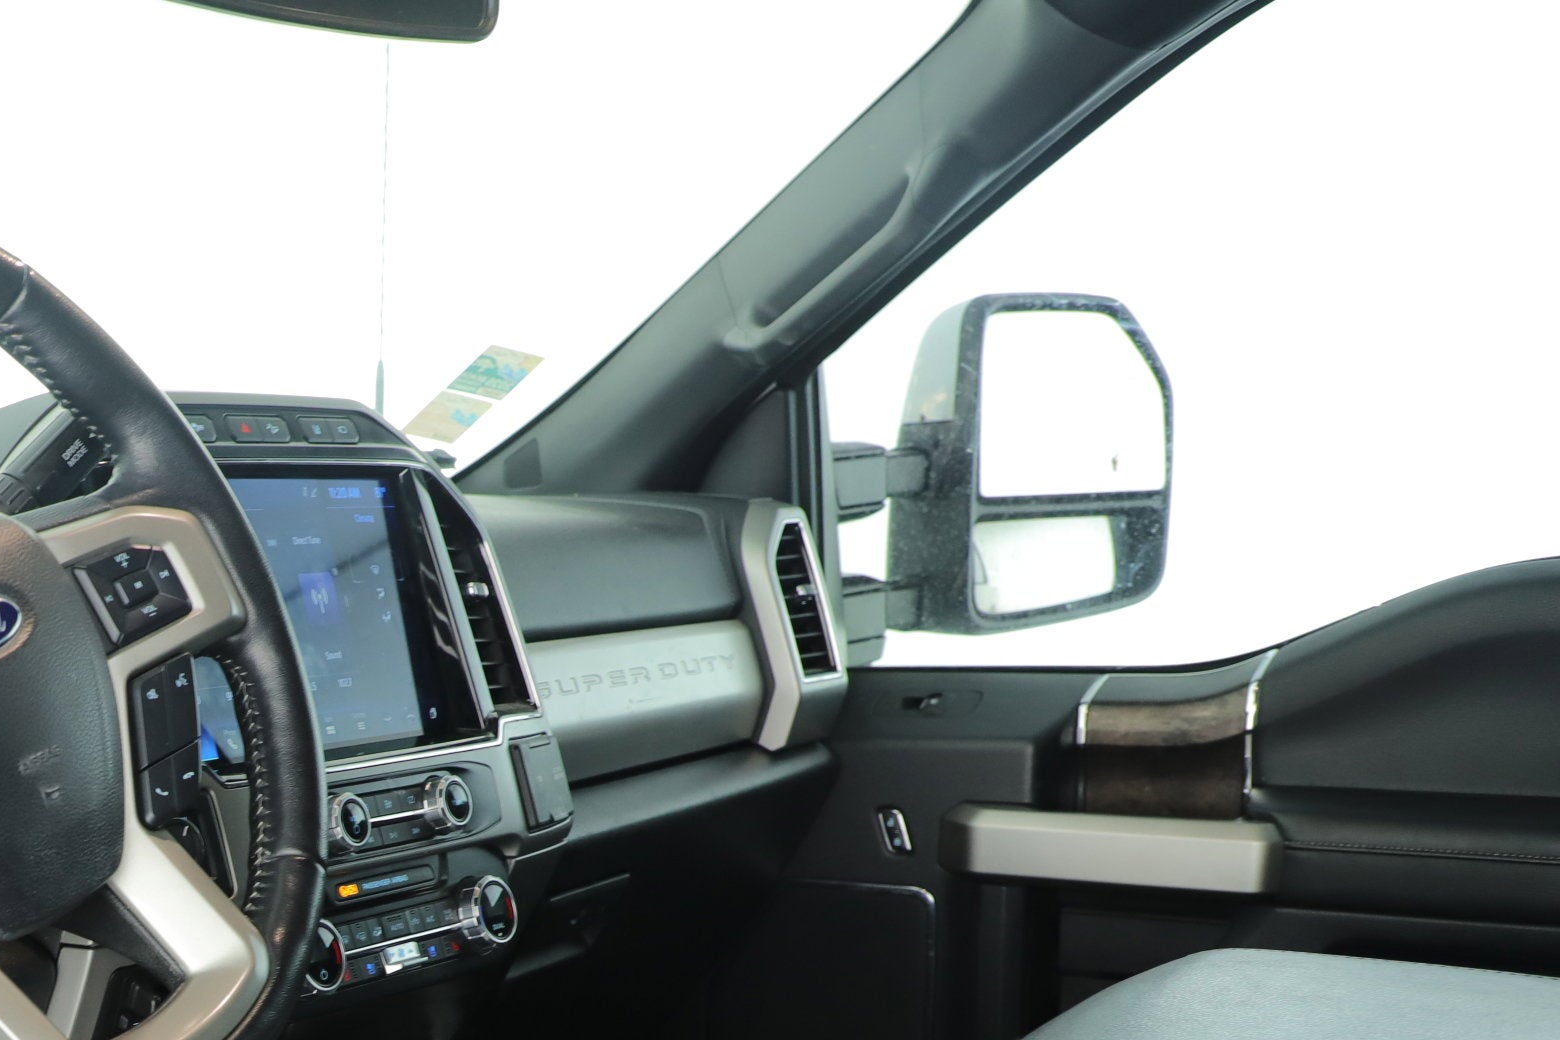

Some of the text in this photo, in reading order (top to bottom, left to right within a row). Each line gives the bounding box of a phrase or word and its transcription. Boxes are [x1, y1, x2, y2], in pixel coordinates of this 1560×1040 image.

[61, 438, 84, 460] DRIVE
[67, 445, 89, 468] MODE
[536, 653, 736, 700] SUPER DUTY
